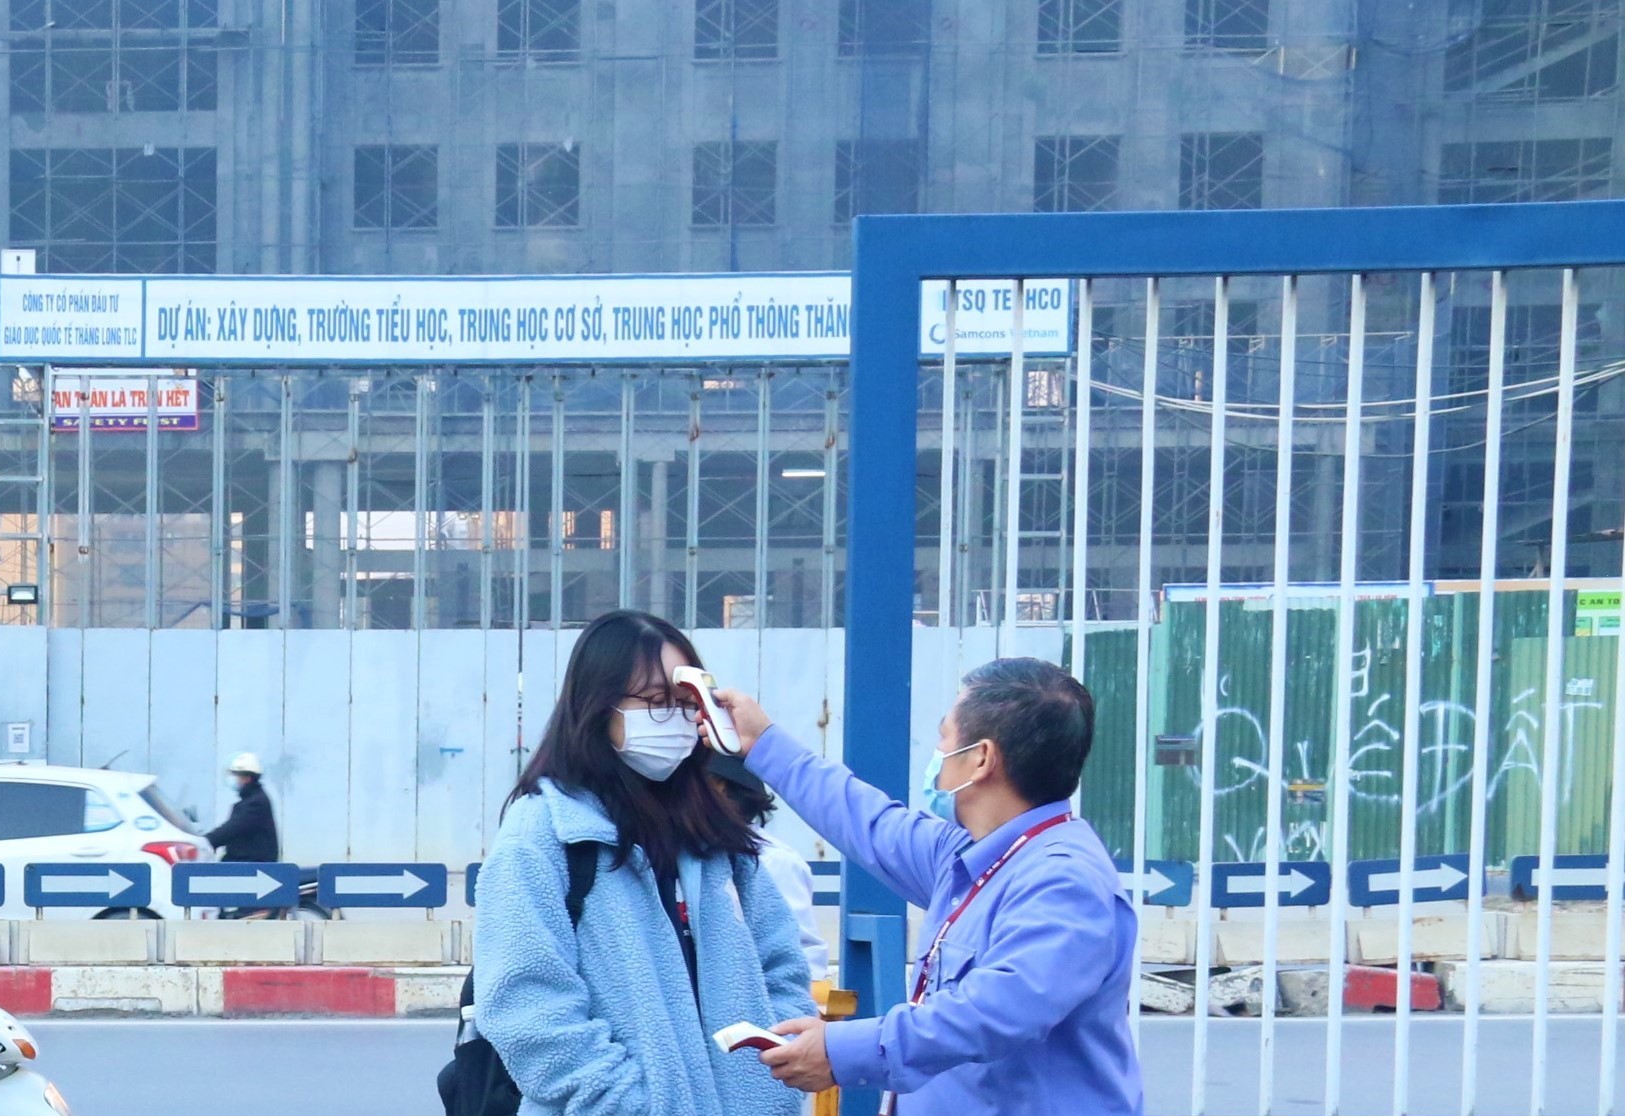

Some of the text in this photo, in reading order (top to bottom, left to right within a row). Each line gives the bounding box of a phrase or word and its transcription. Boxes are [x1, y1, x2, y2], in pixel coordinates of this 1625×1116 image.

[992, 287, 1061, 311] TEHCO
[158, 290, 853, 350] DỰ ÁN: XÂY DỰNG, TRƯỜNG TIỂU HỌC, TRUNG HỌC CƠ SỞ, TRUNG HỌC PHỔ THÔNG THĂN
[74, 387, 108, 408] TÀN
[130, 389, 163, 408] TRN
